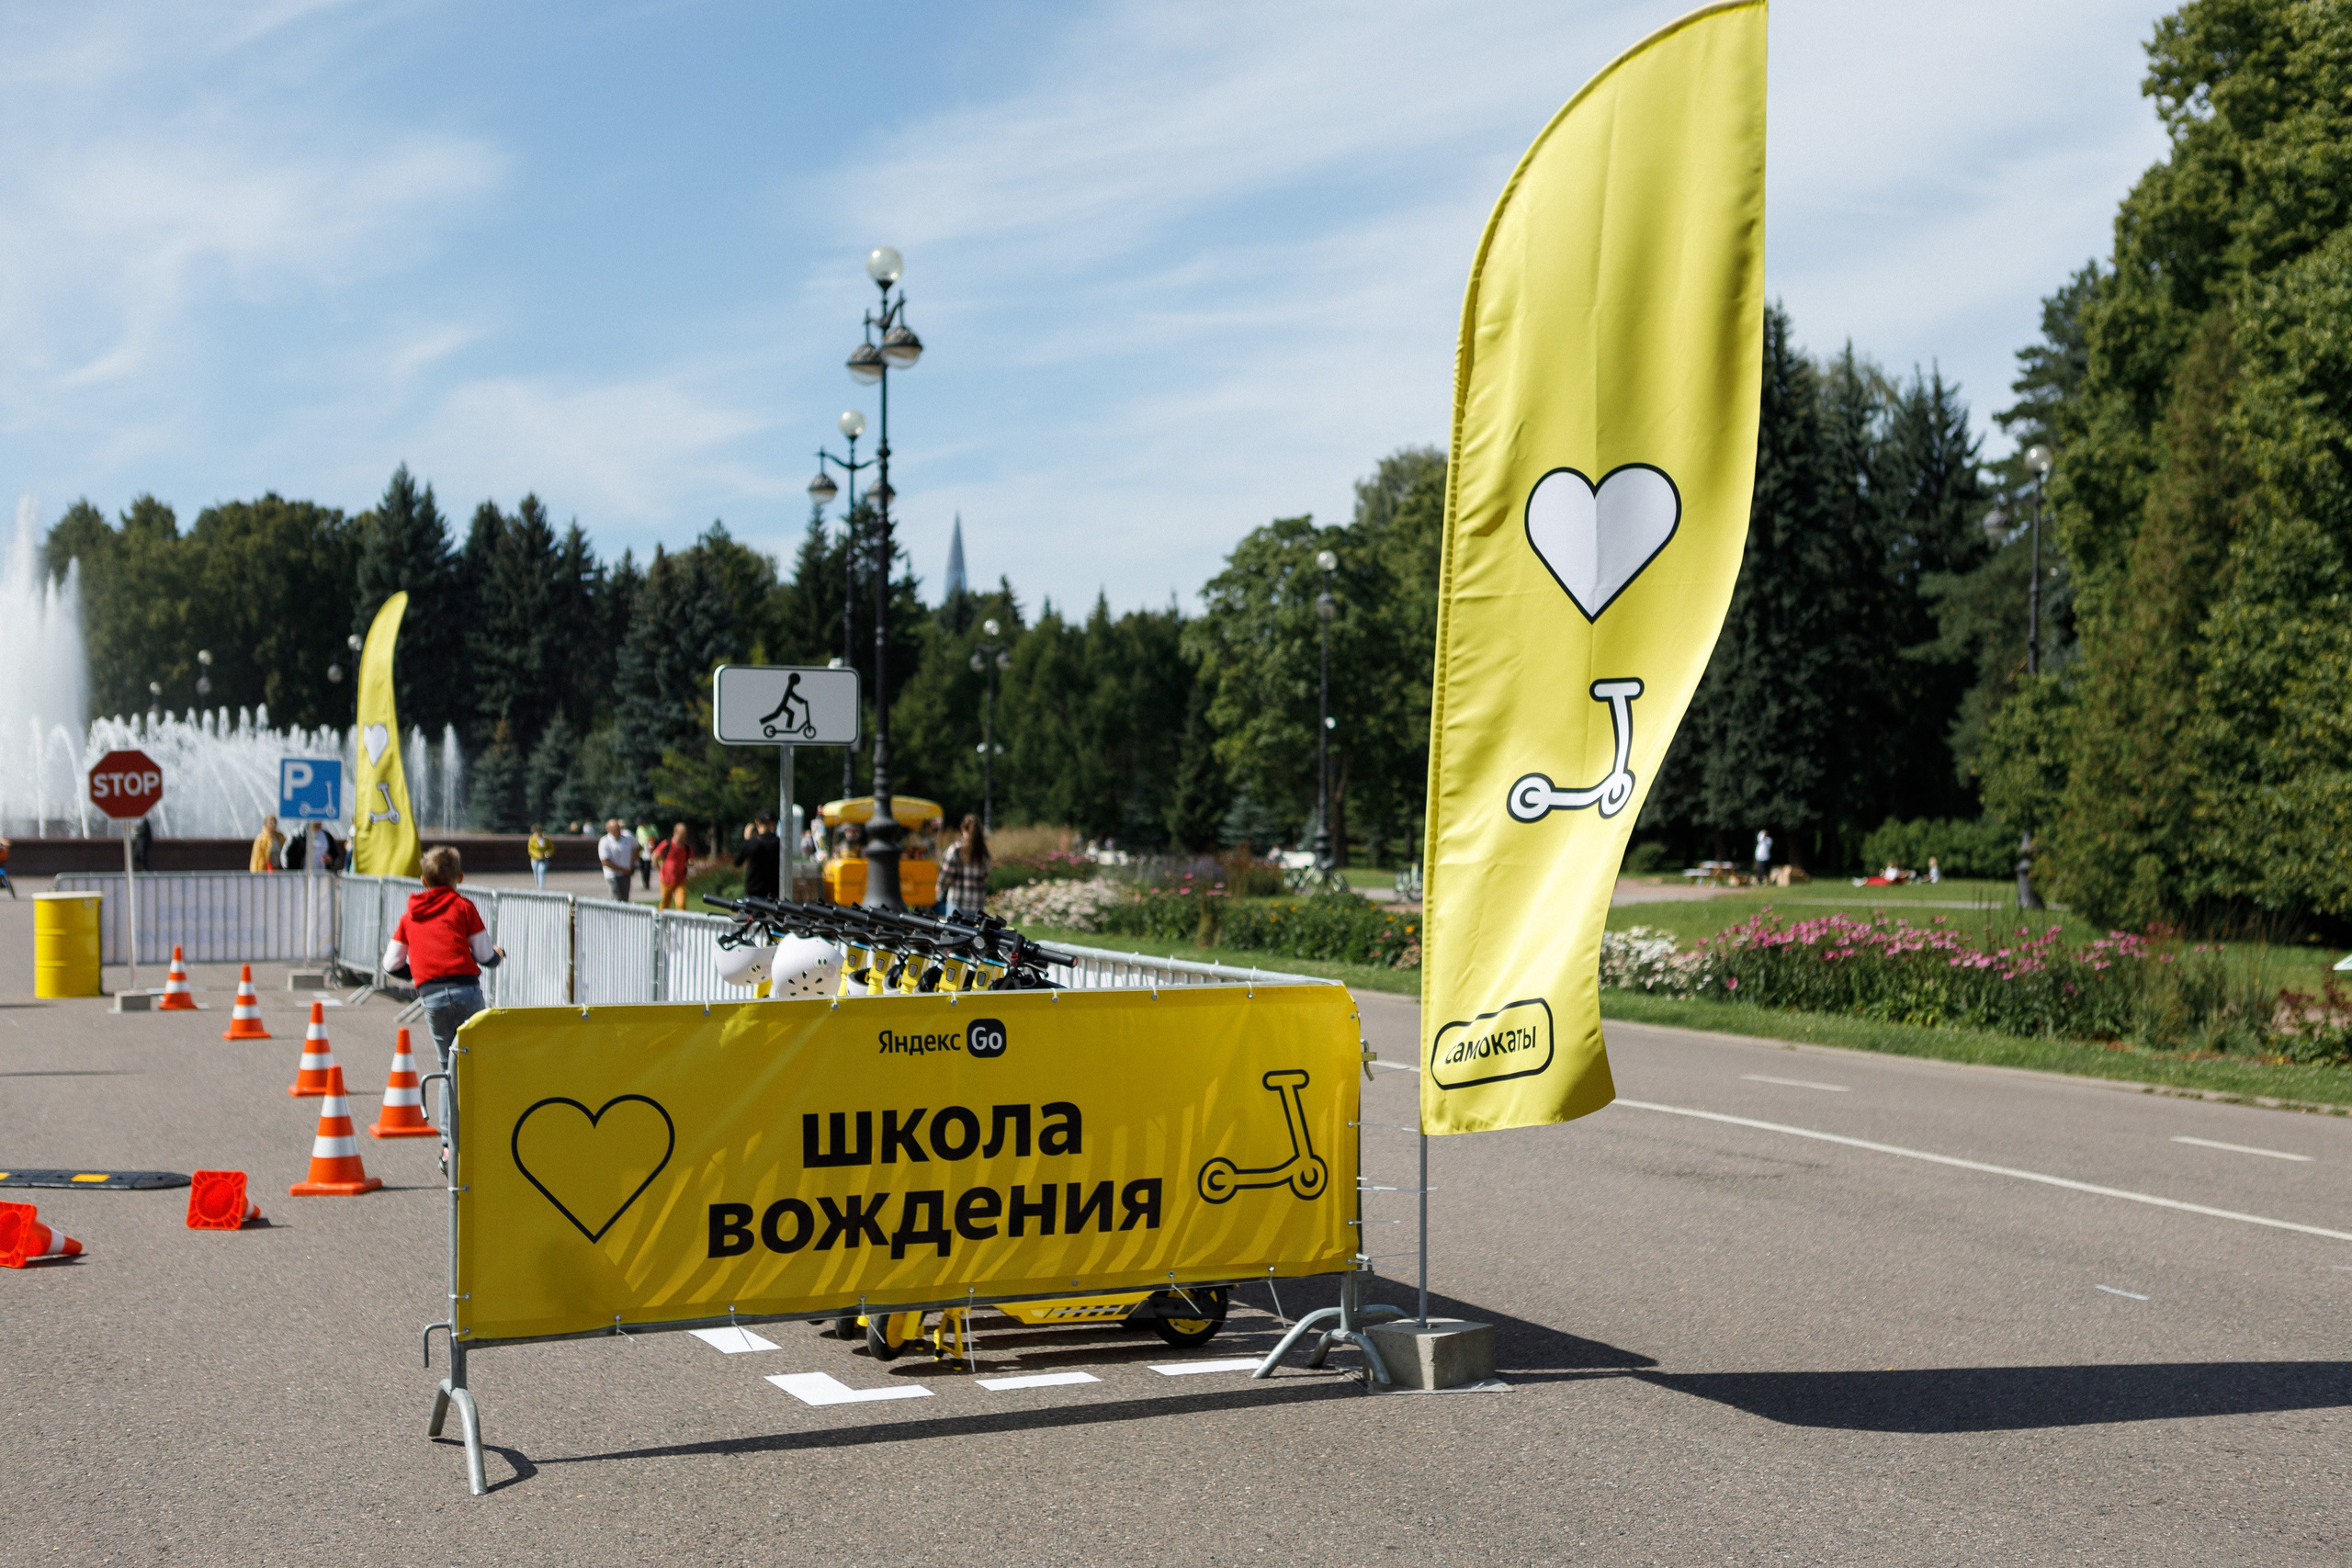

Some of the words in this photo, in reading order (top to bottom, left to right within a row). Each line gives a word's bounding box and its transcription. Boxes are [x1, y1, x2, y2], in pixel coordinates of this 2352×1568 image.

[93, 771, 160, 797] STOP
[284, 762, 313, 800] P
[878, 1030, 961, 1056] Яндекс
[970, 1026, 1002, 1051] Go
[1445, 1026, 1536, 1064] самокаты
[802, 1101, 1082, 1169] школа
[707, 1177, 1163, 1260] вождения
